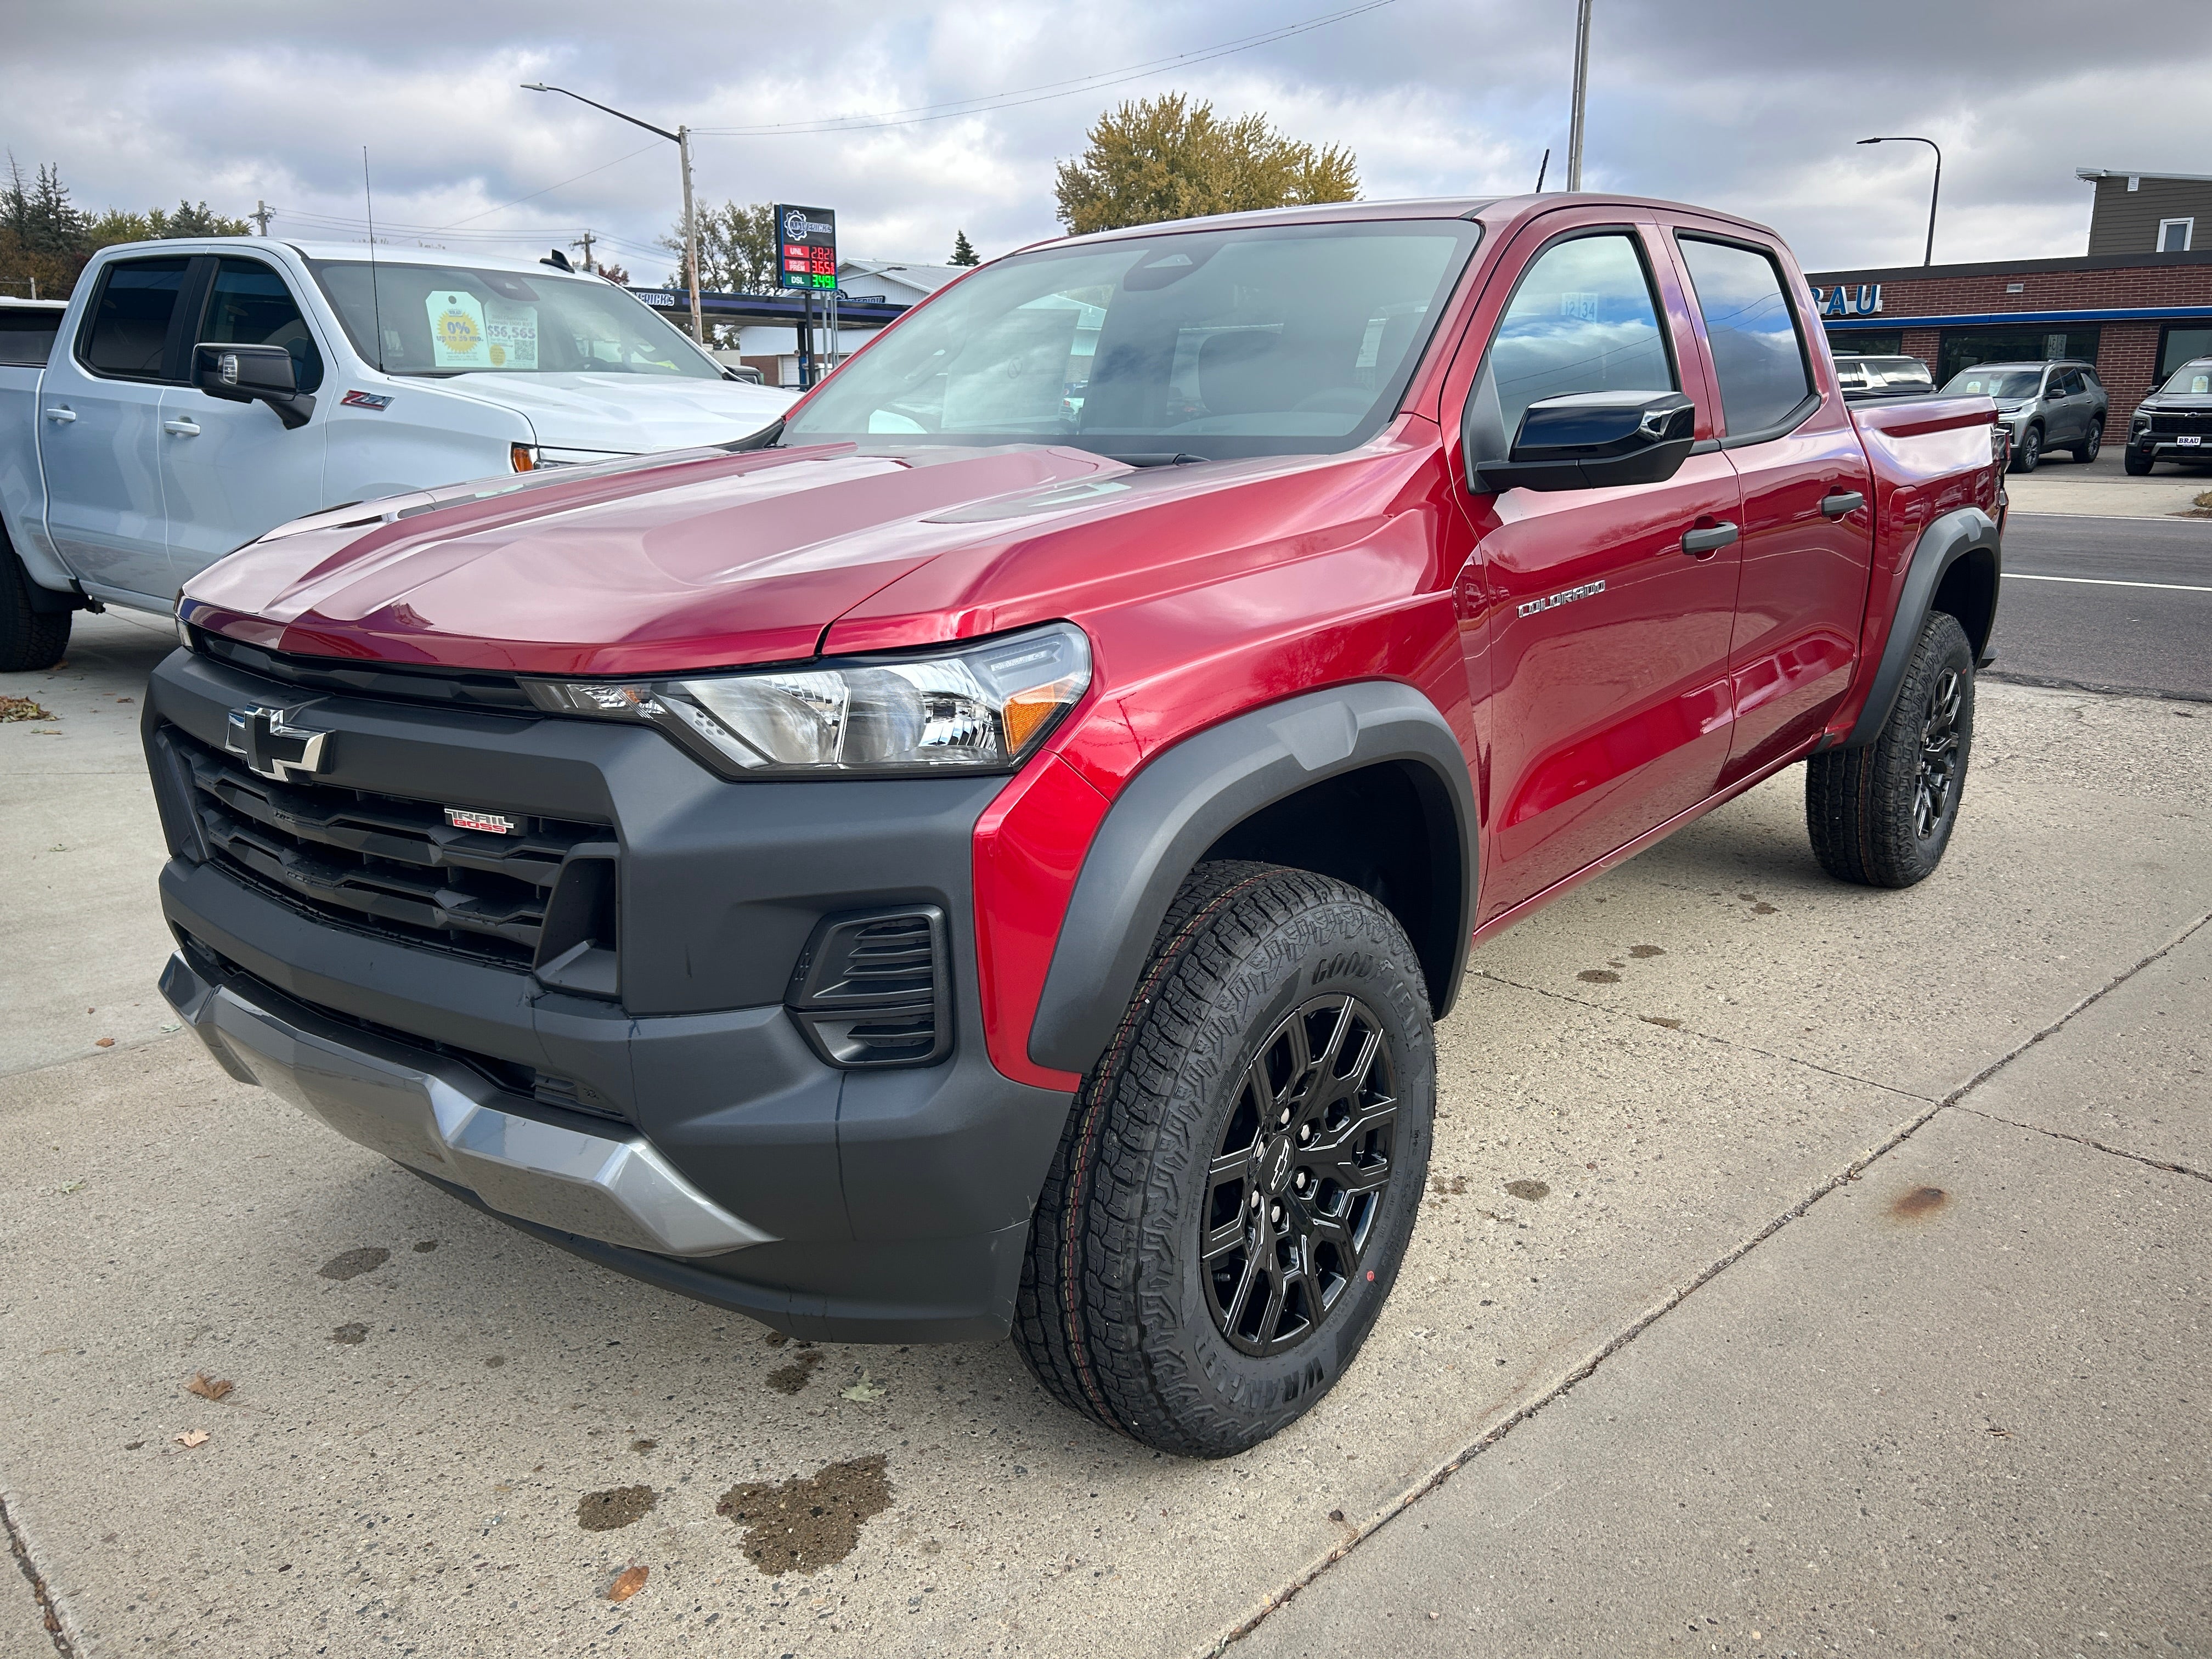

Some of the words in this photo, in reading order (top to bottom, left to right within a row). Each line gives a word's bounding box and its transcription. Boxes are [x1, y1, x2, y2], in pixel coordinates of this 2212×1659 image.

[1582, 302, 1595, 318] 34
[447, 321, 471, 334] 0%
[488, 325, 536, 340] $56,565
[340, 390, 396, 412] Z71
[1518, 580, 1605, 618] COLORADO
[444, 808, 514, 828] TRAIL
[453, 819, 507, 834] BOSS
